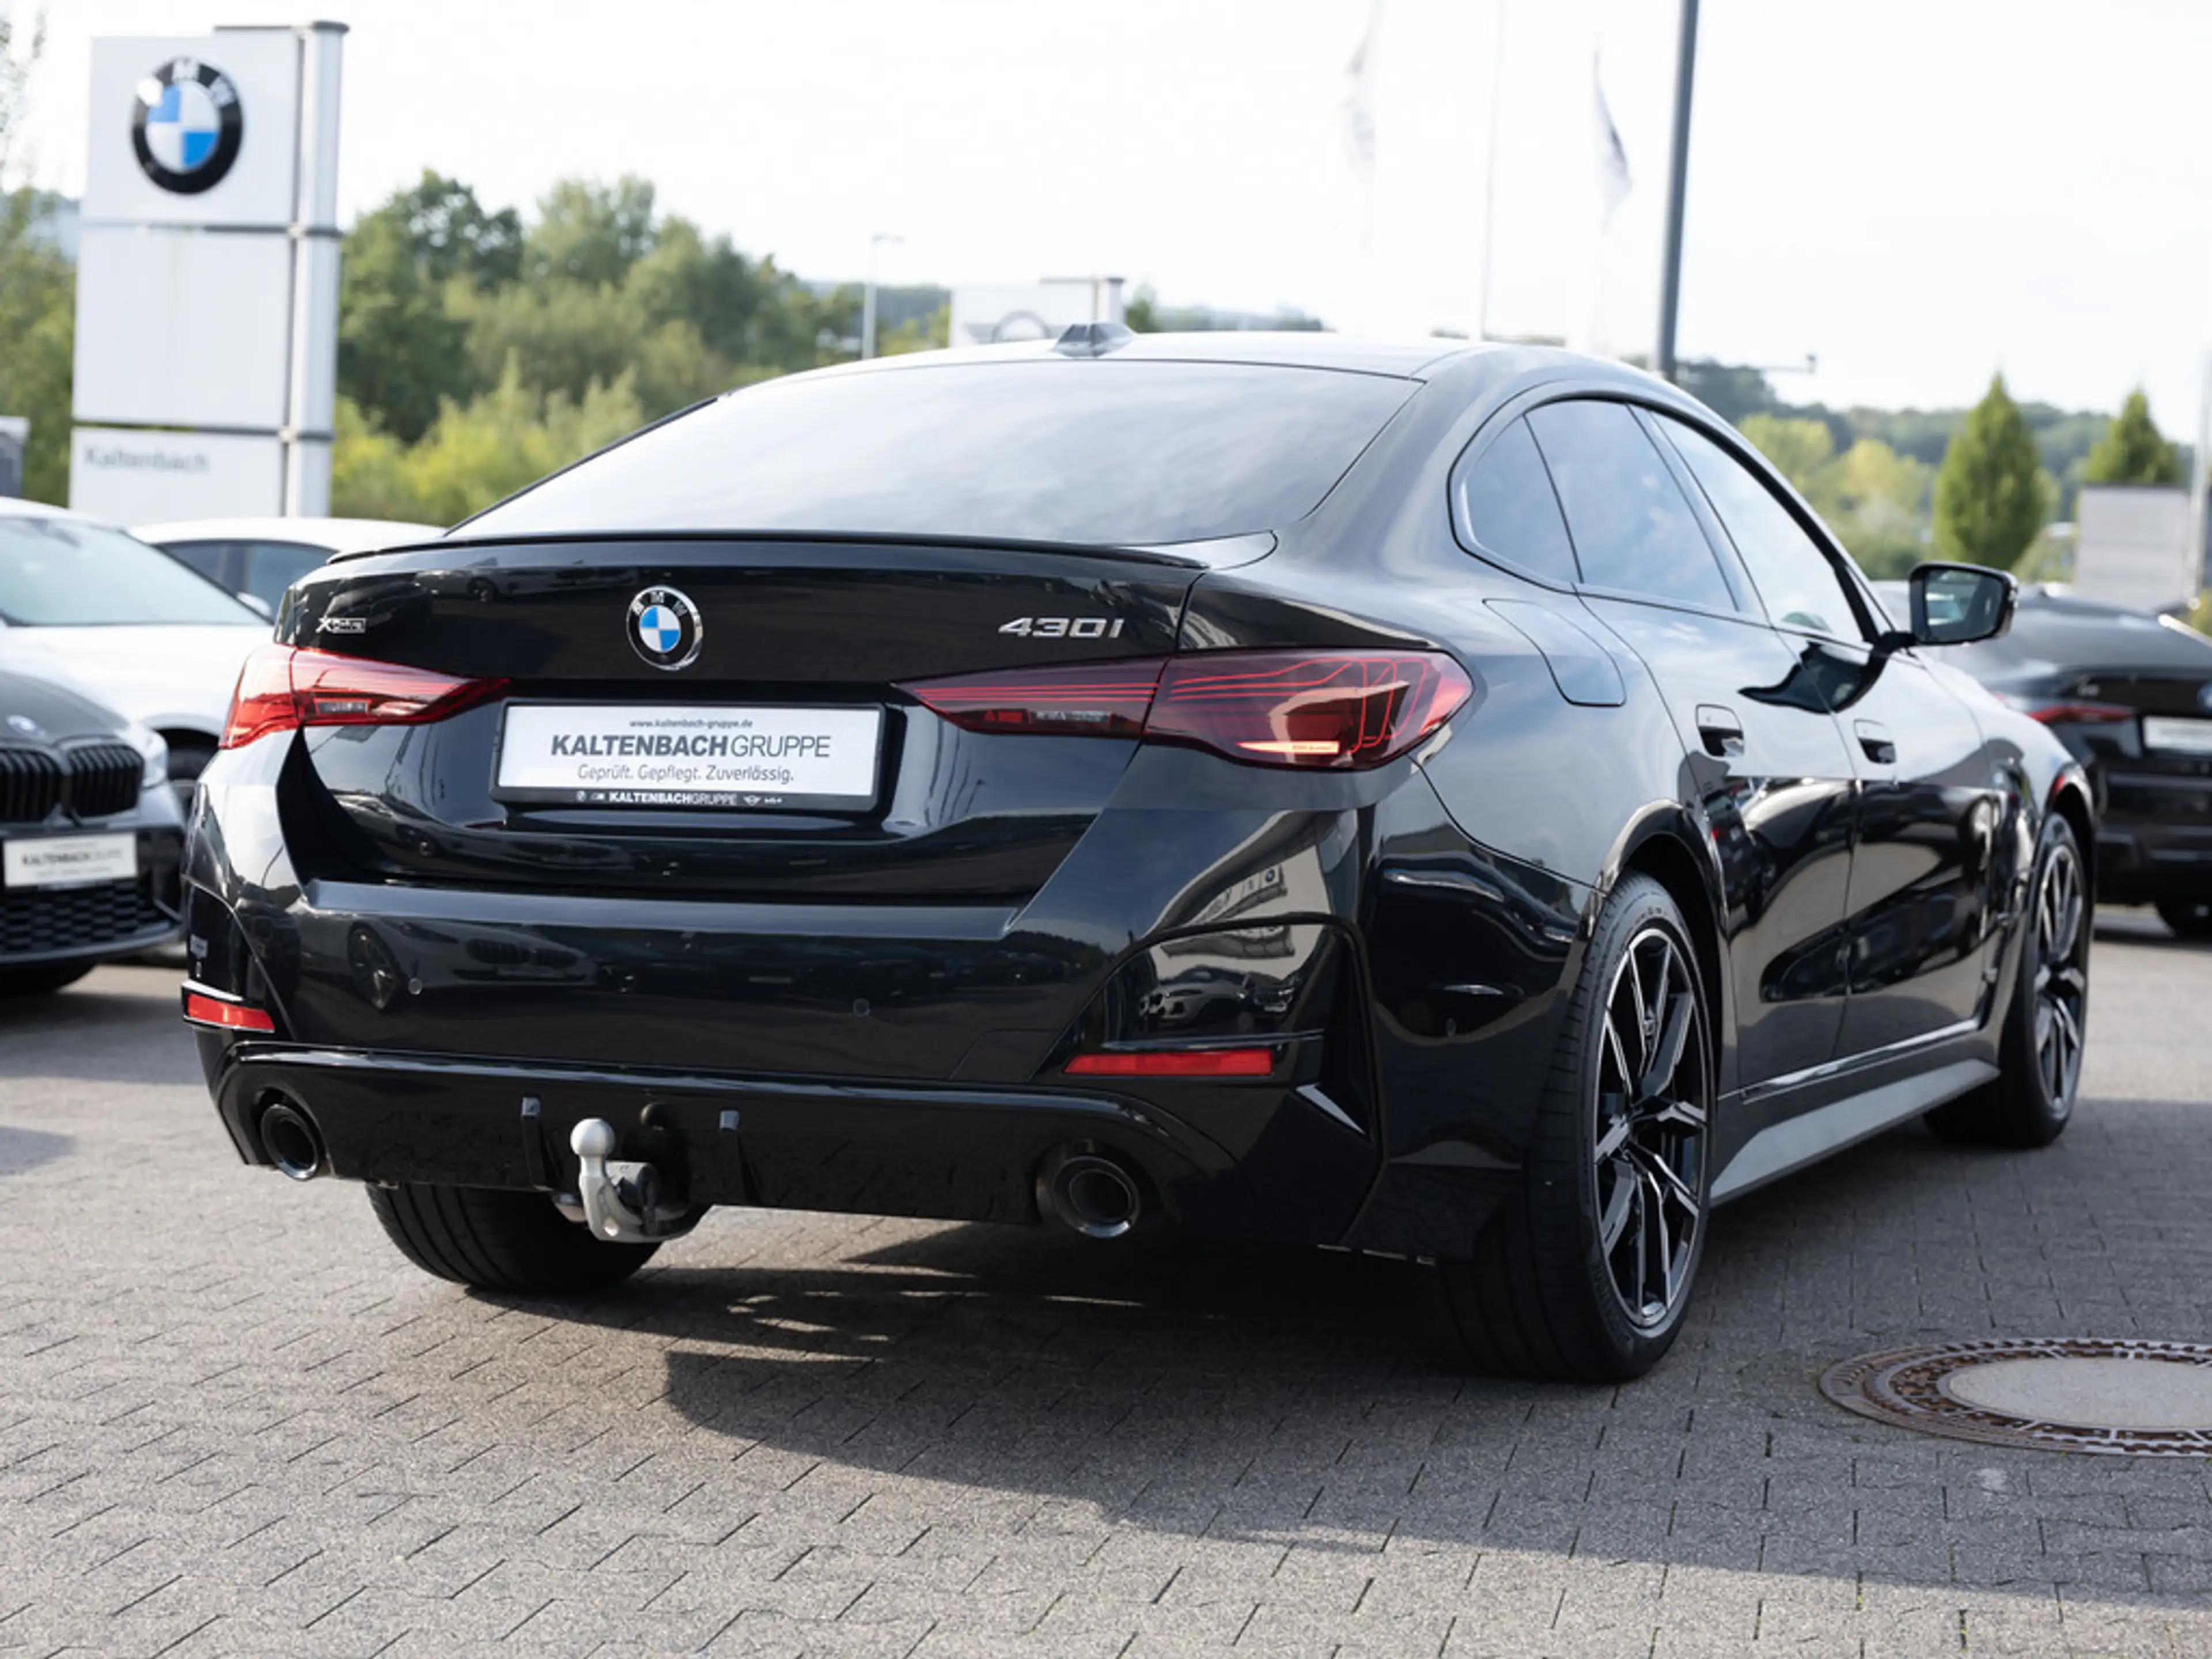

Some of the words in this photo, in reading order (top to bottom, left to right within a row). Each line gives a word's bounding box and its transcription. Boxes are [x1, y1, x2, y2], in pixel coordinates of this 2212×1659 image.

[628, 718, 753, 729] www.kaltenbach-gruppe.de
[577, 764, 634, 782] Geprüft.
[637, 764, 702, 783] Gepflegt.
[705, 764, 794, 785] Zuverlässig.
